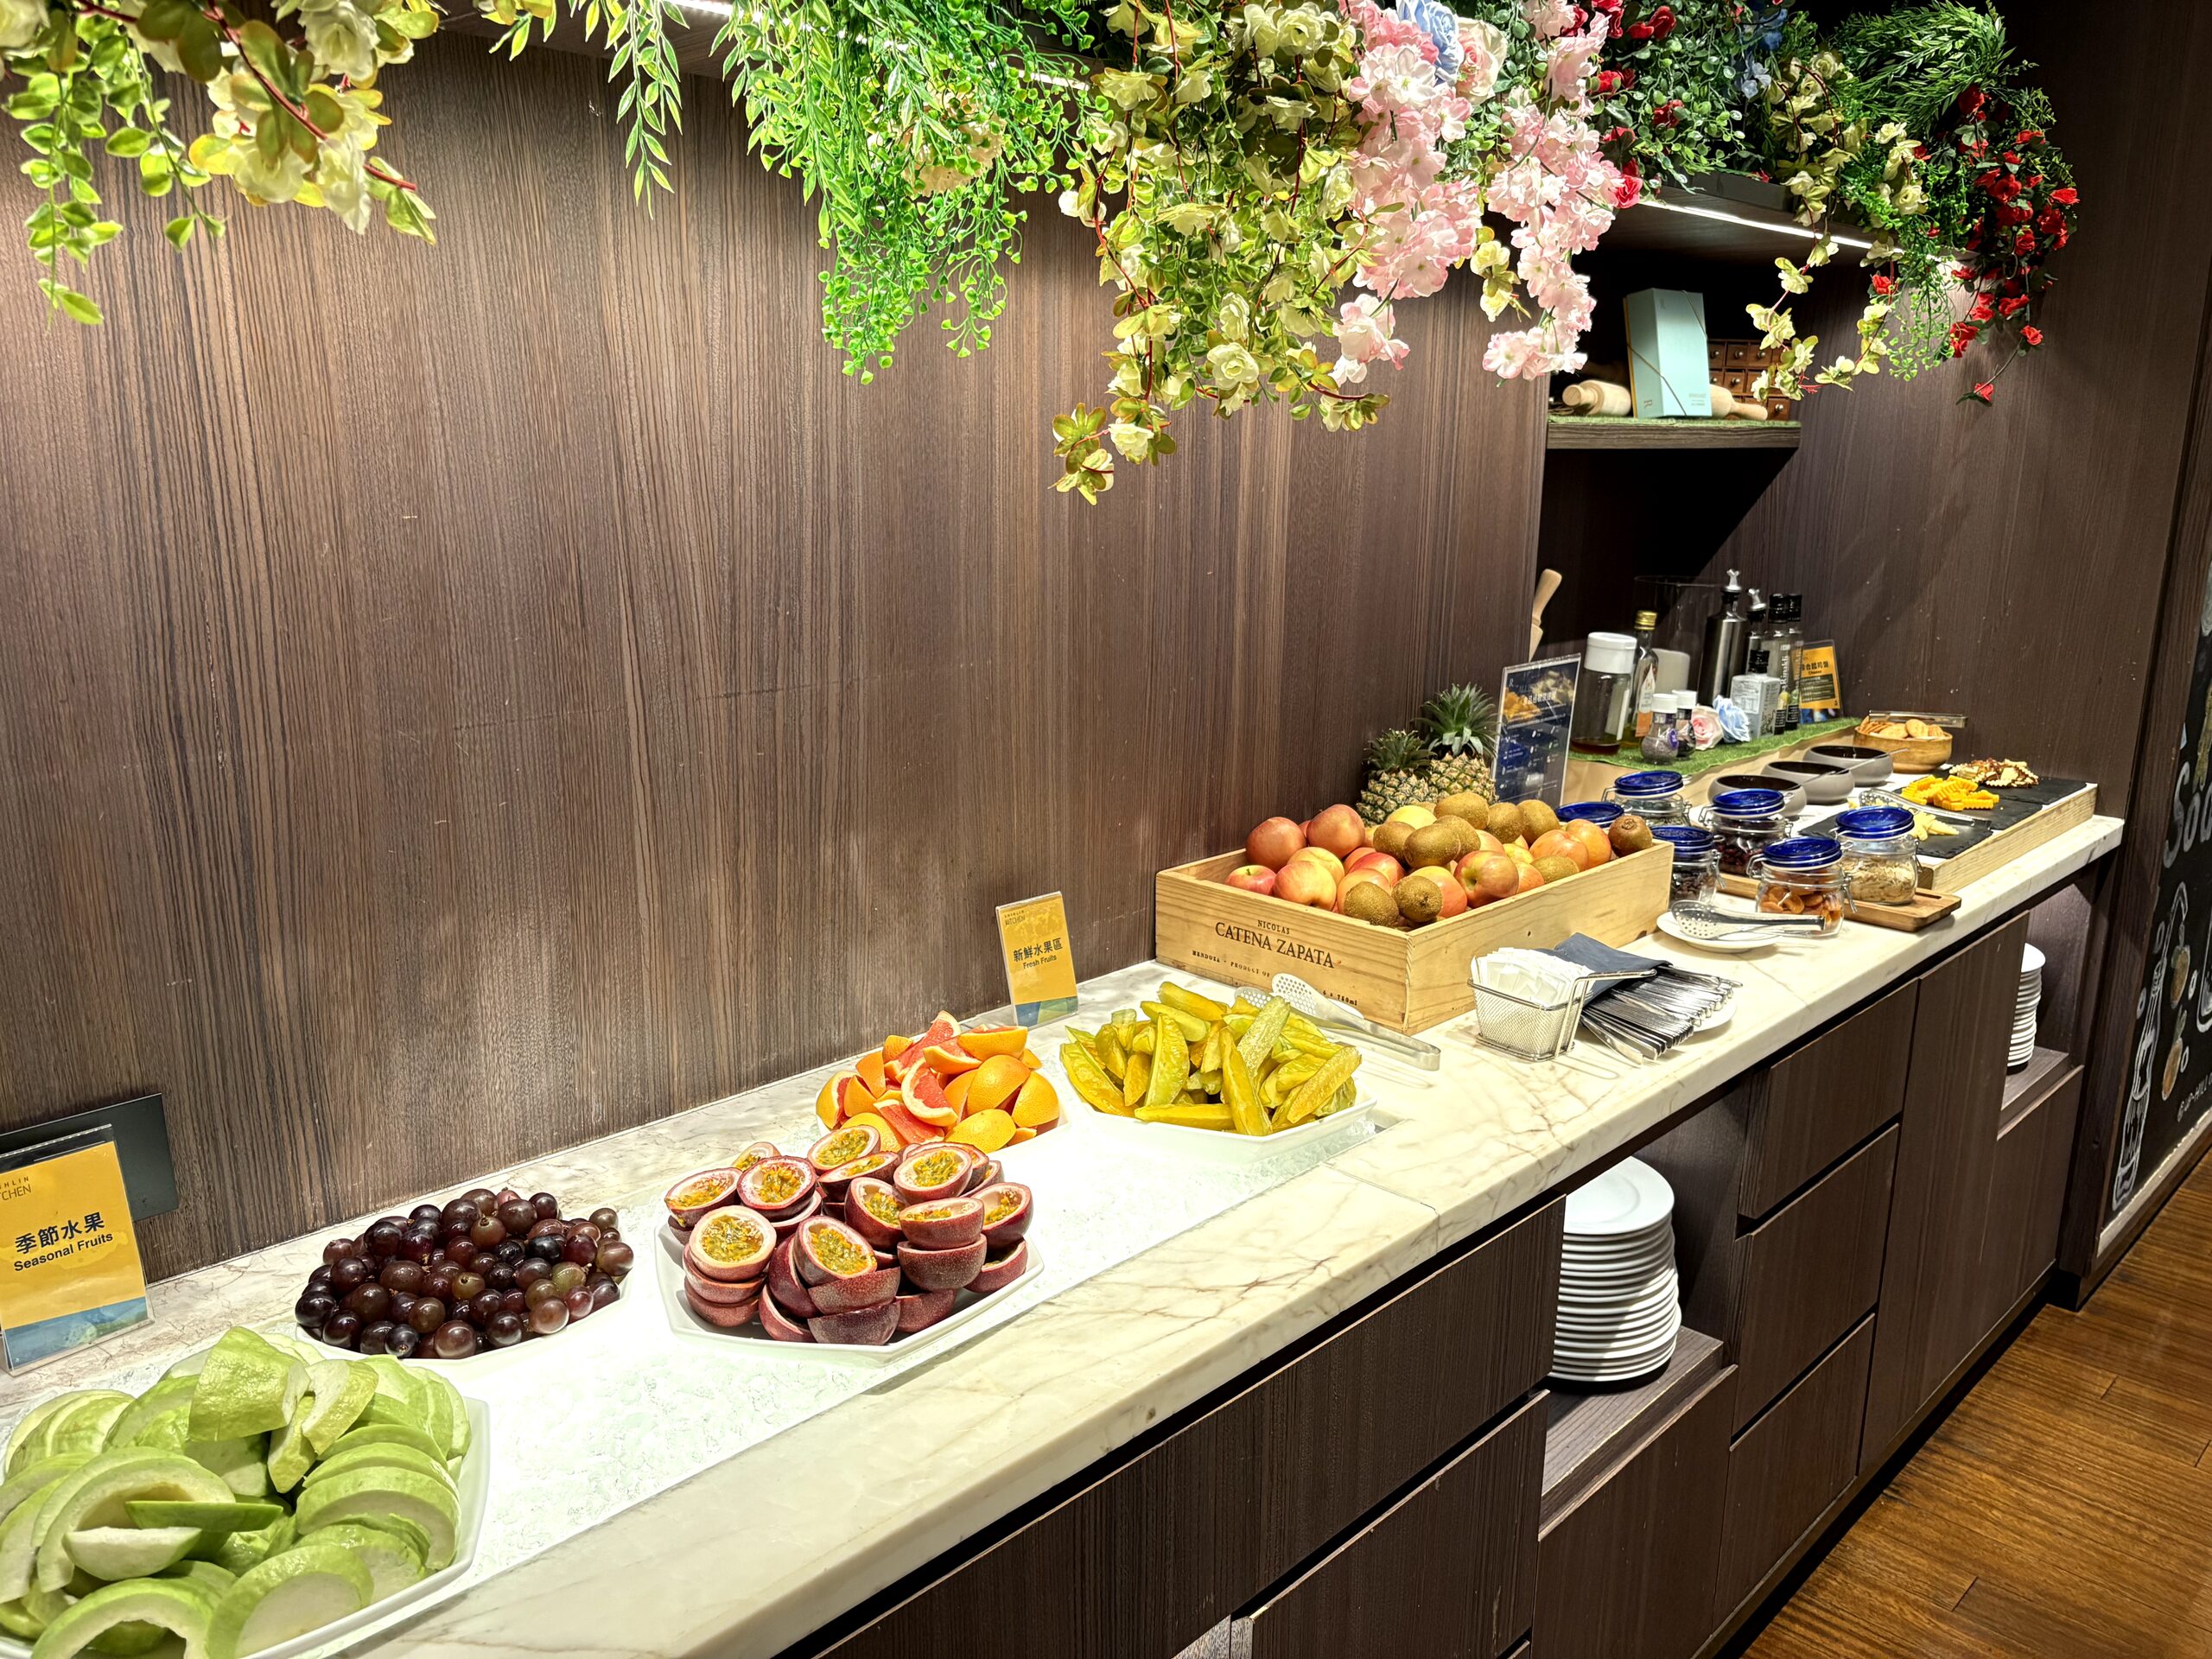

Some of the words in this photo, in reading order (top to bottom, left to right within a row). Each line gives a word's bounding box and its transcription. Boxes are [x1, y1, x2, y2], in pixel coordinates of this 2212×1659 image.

[1257, 919, 1291, 935] NICOLAS
[1013, 938, 1063, 963] 新鮮水果區
[1215, 922, 1273, 951] CATENA
[1276, 938, 1335, 969] ZAPATA
[1022, 959, 1040, 969] Fresh
[1040, 955, 1058, 964] Fruits
[1230, 961, 1260, 975] PRODUCT
[0, 1183, 32, 1201] CHEN
[15, 1211, 105, 1255] 季節水果
[14, 1243, 74, 1272] Seasonal
[77, 1233, 113, 1251] Fruits
